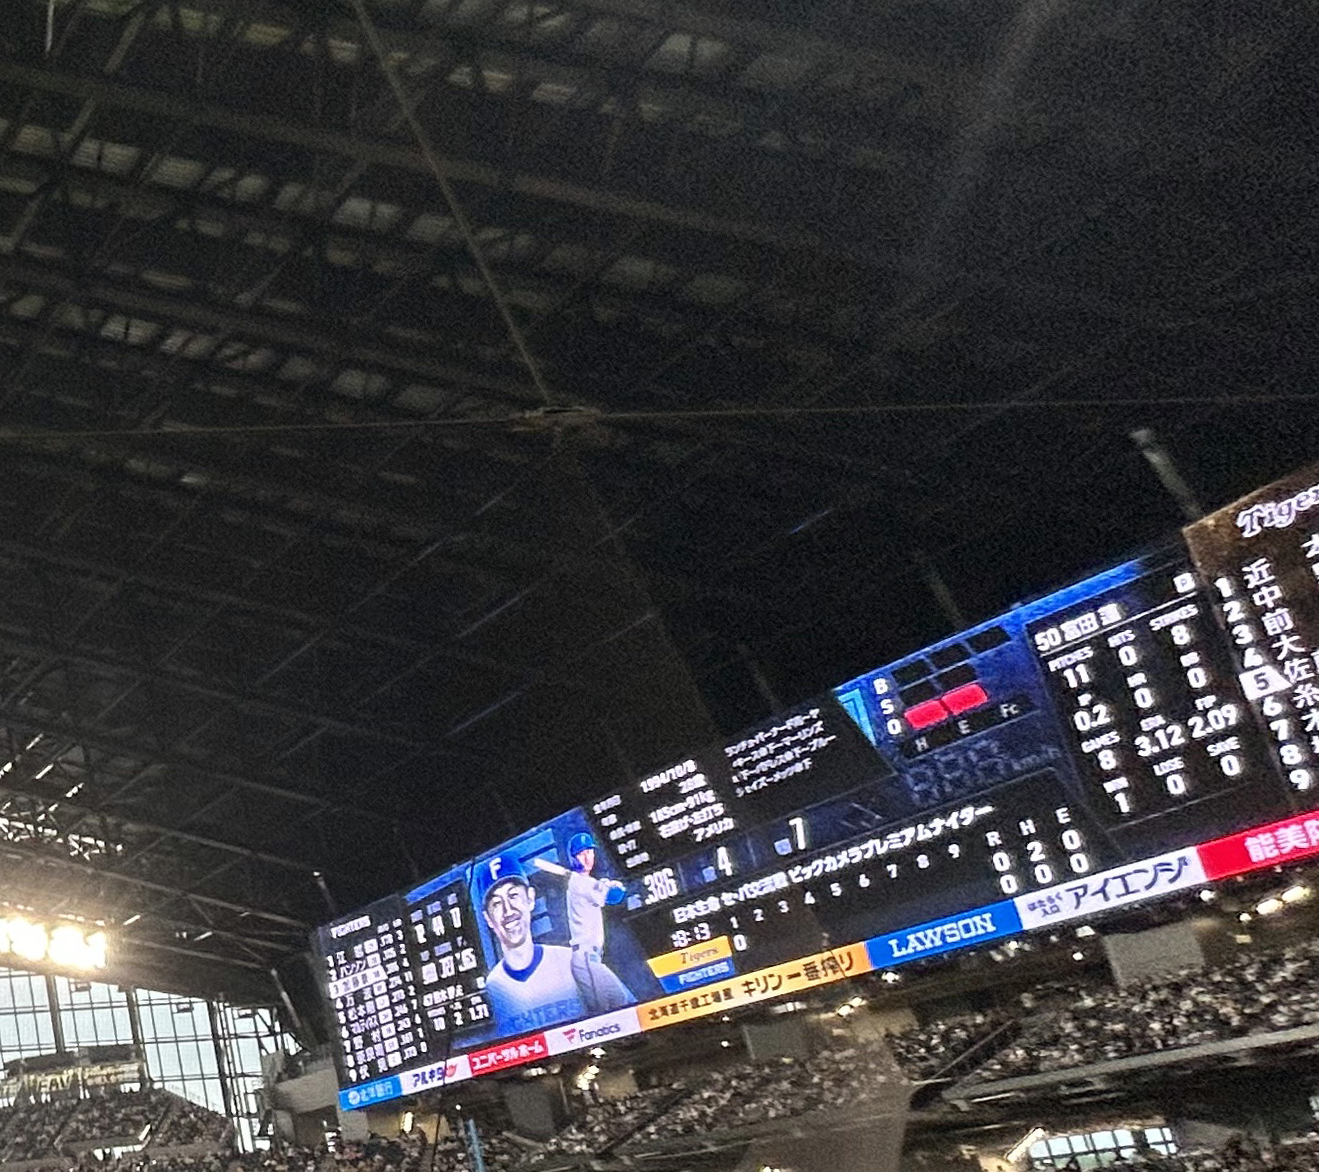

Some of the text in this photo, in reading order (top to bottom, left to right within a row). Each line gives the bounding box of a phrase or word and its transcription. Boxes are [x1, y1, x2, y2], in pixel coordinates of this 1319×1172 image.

[1214, 577, 1232, 598] 1
[1223, 601, 1245, 623] 2
[1035, 627, 1062, 651] 50
[1231, 624, 1253, 645] 3
[1063, 624, 1191, 688] 11 0 8
[1244, 648, 1263, 668] 4
[873, 678, 888, 695] B
[1253, 672, 1270, 691] 5
[880, 699, 895, 715] S
[1074, 667, 1207, 731] 0.2 0 0
[1263, 696, 1282, 717] 6
[1134, 724, 1185, 757] 3.12
[1188, 704, 1238, 740] 2.09
[1269, 719, 1289, 740] 7
[1098, 749, 1117, 770] 8
[1280, 744, 1302, 765] 8
[1166, 754, 1242, 795] 0 0
[1289, 768, 1310, 791] 9
[985, 830, 1002, 847] R
[716, 846, 733, 876] 4
[1027, 841, 1046, 862] 2
[887, 912, 997, 958] LAWSON
[741, 950, 855, 998] キリン一番搾り
[579, 1022, 621, 1042] Fanatics
